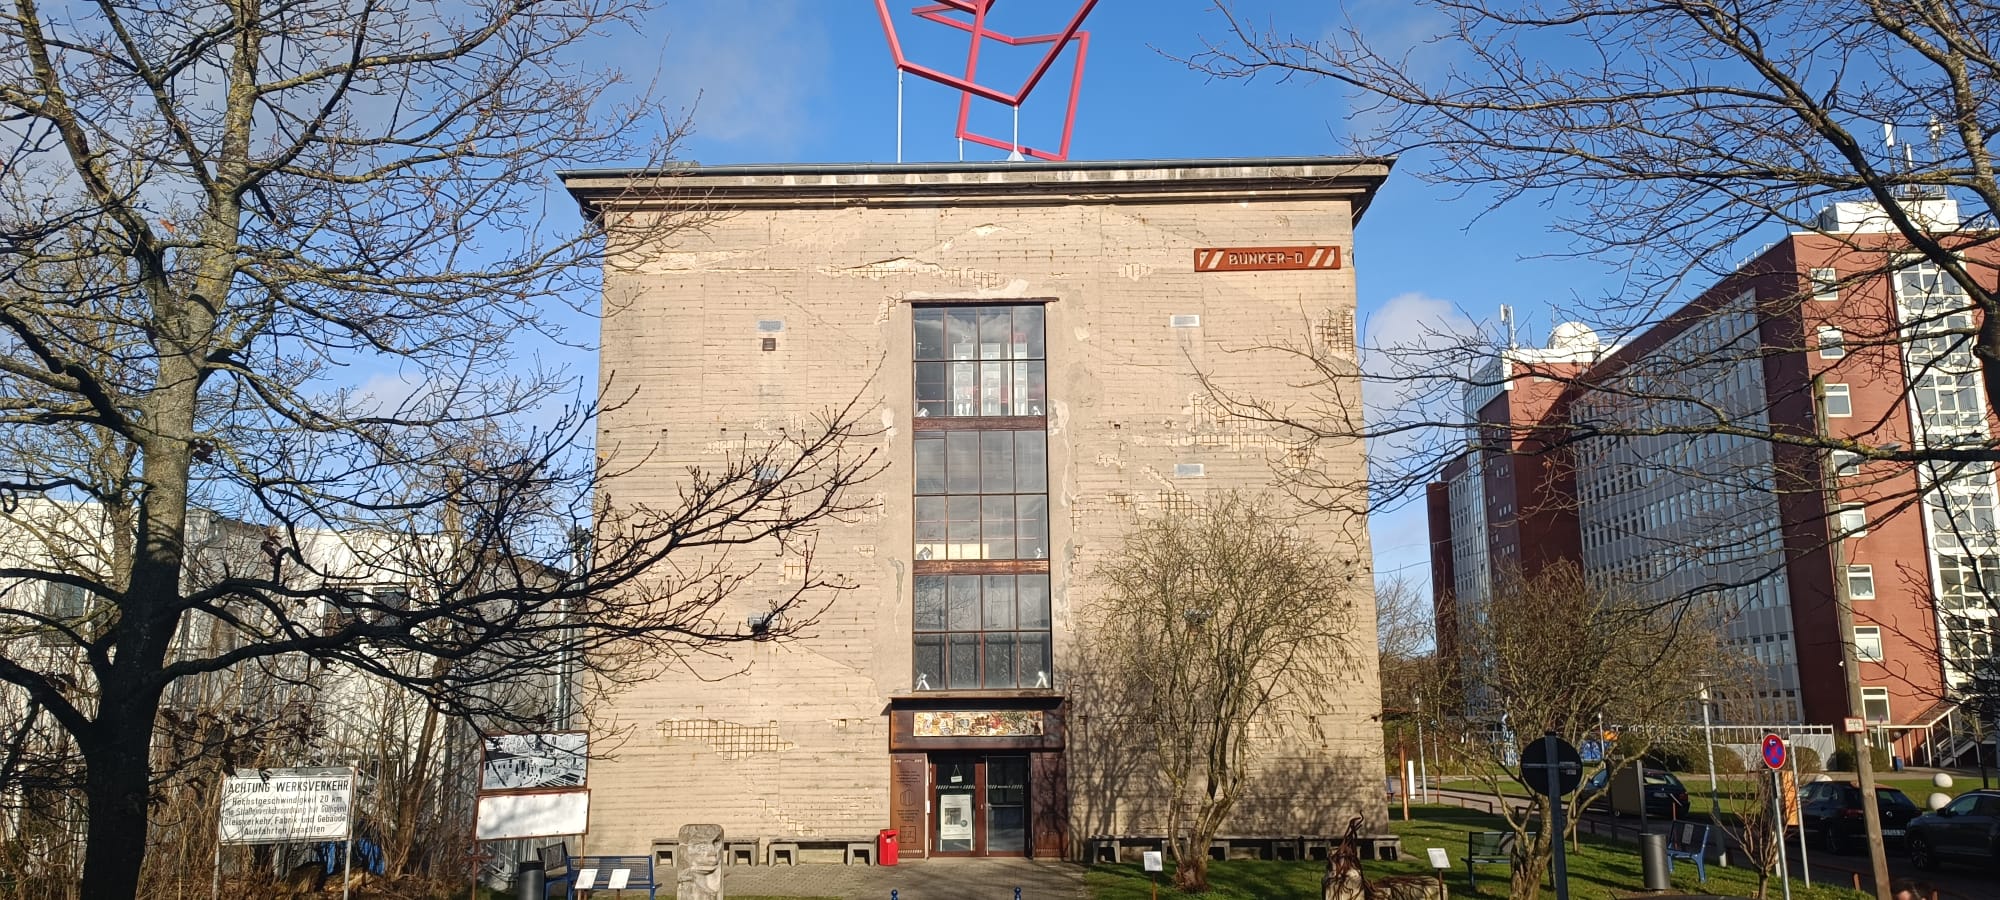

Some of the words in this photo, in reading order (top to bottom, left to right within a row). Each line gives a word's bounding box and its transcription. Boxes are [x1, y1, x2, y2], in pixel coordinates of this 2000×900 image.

[1229, 251, 1304, 265] BUNKER-D
[228, 782, 271, 793] ACHTUNG
[276, 780, 349, 792] WERKSVERKEHR
[320, 795, 329, 803] 20
[331, 795, 342, 803] km
